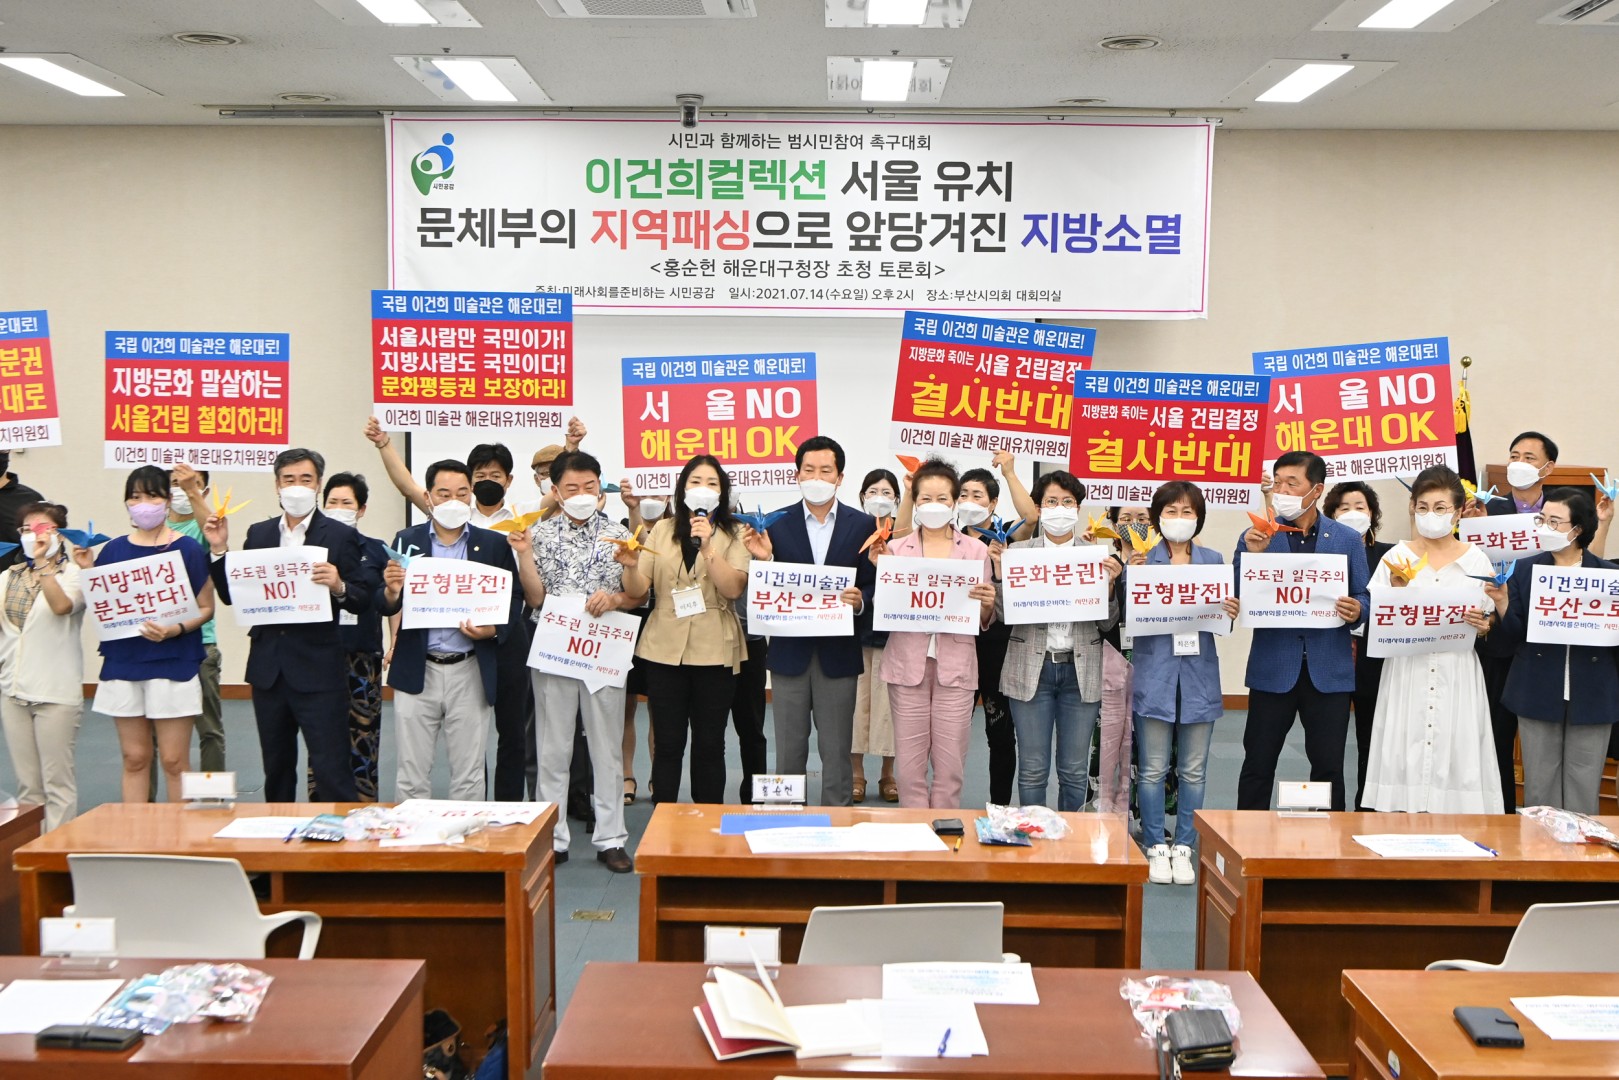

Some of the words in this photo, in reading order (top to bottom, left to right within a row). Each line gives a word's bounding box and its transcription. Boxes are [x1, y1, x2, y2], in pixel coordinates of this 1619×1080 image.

[668, 133, 714, 150] 시민과
[720, 133, 781, 150] 함께하는
[788, 134, 864, 150] 범시민참여
[870, 134, 931, 150] 촉구대회
[586, 158, 826, 200] 이건희컬렉션
[841, 160, 921, 201] 서울
[934, 161, 1012, 202] 유치
[416, 208, 576, 248] 문체부의
[590, 209, 833, 250] 지역패싱으로
[846, 211, 1006, 253] 앞당겨진
[1020, 212, 1182, 254] 지방소멸
[650, 258, 716, 278] <홍순헌
[723, 259, 830, 278] 해운대구청장
[836, 261, 872, 278] 초청
[878, 261, 945, 279] 토론회>
[382, 296, 407, 312] 국립
[412, 296, 448, 313] 이건희
[454, 297, 504, 314] 미술관은
[508, 298, 562, 314] 해운대로!
[669, 286, 715, 299] 시민공감
[926, 290, 1012, 302] 장소:부산시의회
[1016, 290, 1062, 302] 대회의실
[380, 326, 476, 348] 서울사람만
[483, 328, 566, 350] 국민이가!
[914, 318, 938, 336] 국립
[942, 320, 978, 339] 이건희
[982, 324, 1030, 344] 미술관은
[1034, 329, 1085, 350] 해운대로!
[114, 337, 138, 354] 국립
[142, 338, 176, 354] 이건희
[180, 338, 226, 354] 미술관은
[230, 338, 280, 356] 해운대로!
[1264, 356, 1288, 372] 국립
[1292, 353, 1328, 370] 이건희
[1333, 348, 1380, 367] 미술관은
[1385, 343, 1438, 363] 해운대로!
[380, 352, 476, 372] 지방사람도
[483, 353, 566, 374] 국민이다!
[632, 362, 656, 378] 국립
[661, 361, 696, 378] 이건희
[702, 360, 749, 376] 미술관은
[754, 358, 806, 375] 해운대로!
[908, 346, 945, 363] 지방문화
[948, 349, 974, 366] 죽이는
[975, 352, 1010, 376] 서울
[1016, 356, 1082, 384] 건립결정
[112, 367, 194, 397] 지방문화
[201, 369, 282, 398] 말살하는
[382, 376, 476, 397] 문화평등권
[484, 378, 566, 398] 보장하라!
[1085, 376, 1108, 392] 국립
[1114, 378, 1149, 394] 이건희
[1154, 378, 1202, 396] 미술관은
[1207, 380, 1260, 397] 해운대로!
[1379, 372, 1436, 406] NO
[0, 383, 48, 413] 대로
[746, 387, 802, 420] NO
[911, 381, 1073, 430] 결사반대
[111, 404, 190, 434] 서울건립
[198, 406, 282, 436] 철회하라!
[386, 410, 420, 426] 이건희
[426, 410, 461, 426] 미술관
[466, 410, 562, 428] 해운대유치위원회
[1082, 404, 1118, 419] 지방문화
[1121, 406, 1148, 420] 죽이는
[1150, 406, 1184, 428] 서울
[1190, 408, 1259, 432] 건립결정
[1274, 415, 1373, 452] 해운대
[1381, 410, 1438, 445] OK
[640, 427, 738, 461] 해운대
[746, 426, 800, 458] OK
[900, 428, 934, 446] 이건희
[940, 431, 974, 449] 미술관
[977, 434, 1069, 458] 해운대유치위원회
[115, 447, 148, 464] 이건희
[152, 448, 184, 464] 미술관
[188, 448, 278, 466] 해운대유치위원회
[1087, 438, 1251, 477] 결사반대
[1325, 460, 1347, 478] 술관
[1350, 452, 1446, 476] 해운대유치위원회
[636, 473, 670, 490] 이건희
[1118, 486, 1152, 502] 미술관
[89, 561, 176, 594] 지방패싱
[230, 565, 267, 580] 수도권
[274, 562, 316, 578] 일극주
[756, 571, 850, 590] 이건희미술관
[880, 571, 919, 586] 수도권
[928, 574, 980, 588] 일극주의
[1007, 562, 1104, 588] 문화분권!
[1244, 569, 1284, 583] 수도권
[1292, 569, 1344, 583] 일극주의
[264, 580, 296, 600] NO!
[409, 574, 506, 594] 균형발전!
[1132, 582, 1229, 605] 균형발전!
[1276, 586, 1310, 604] NO!
[94, 584, 188, 622] 분노한다!
[752, 591, 846, 612] 부산으로
[910, 591, 944, 608] NO!
[1375, 604, 1476, 626] 균형발전
[544, 611, 580, 632] 수도권
[588, 622, 634, 642] 일극주의
[567, 636, 601, 658] NO!
